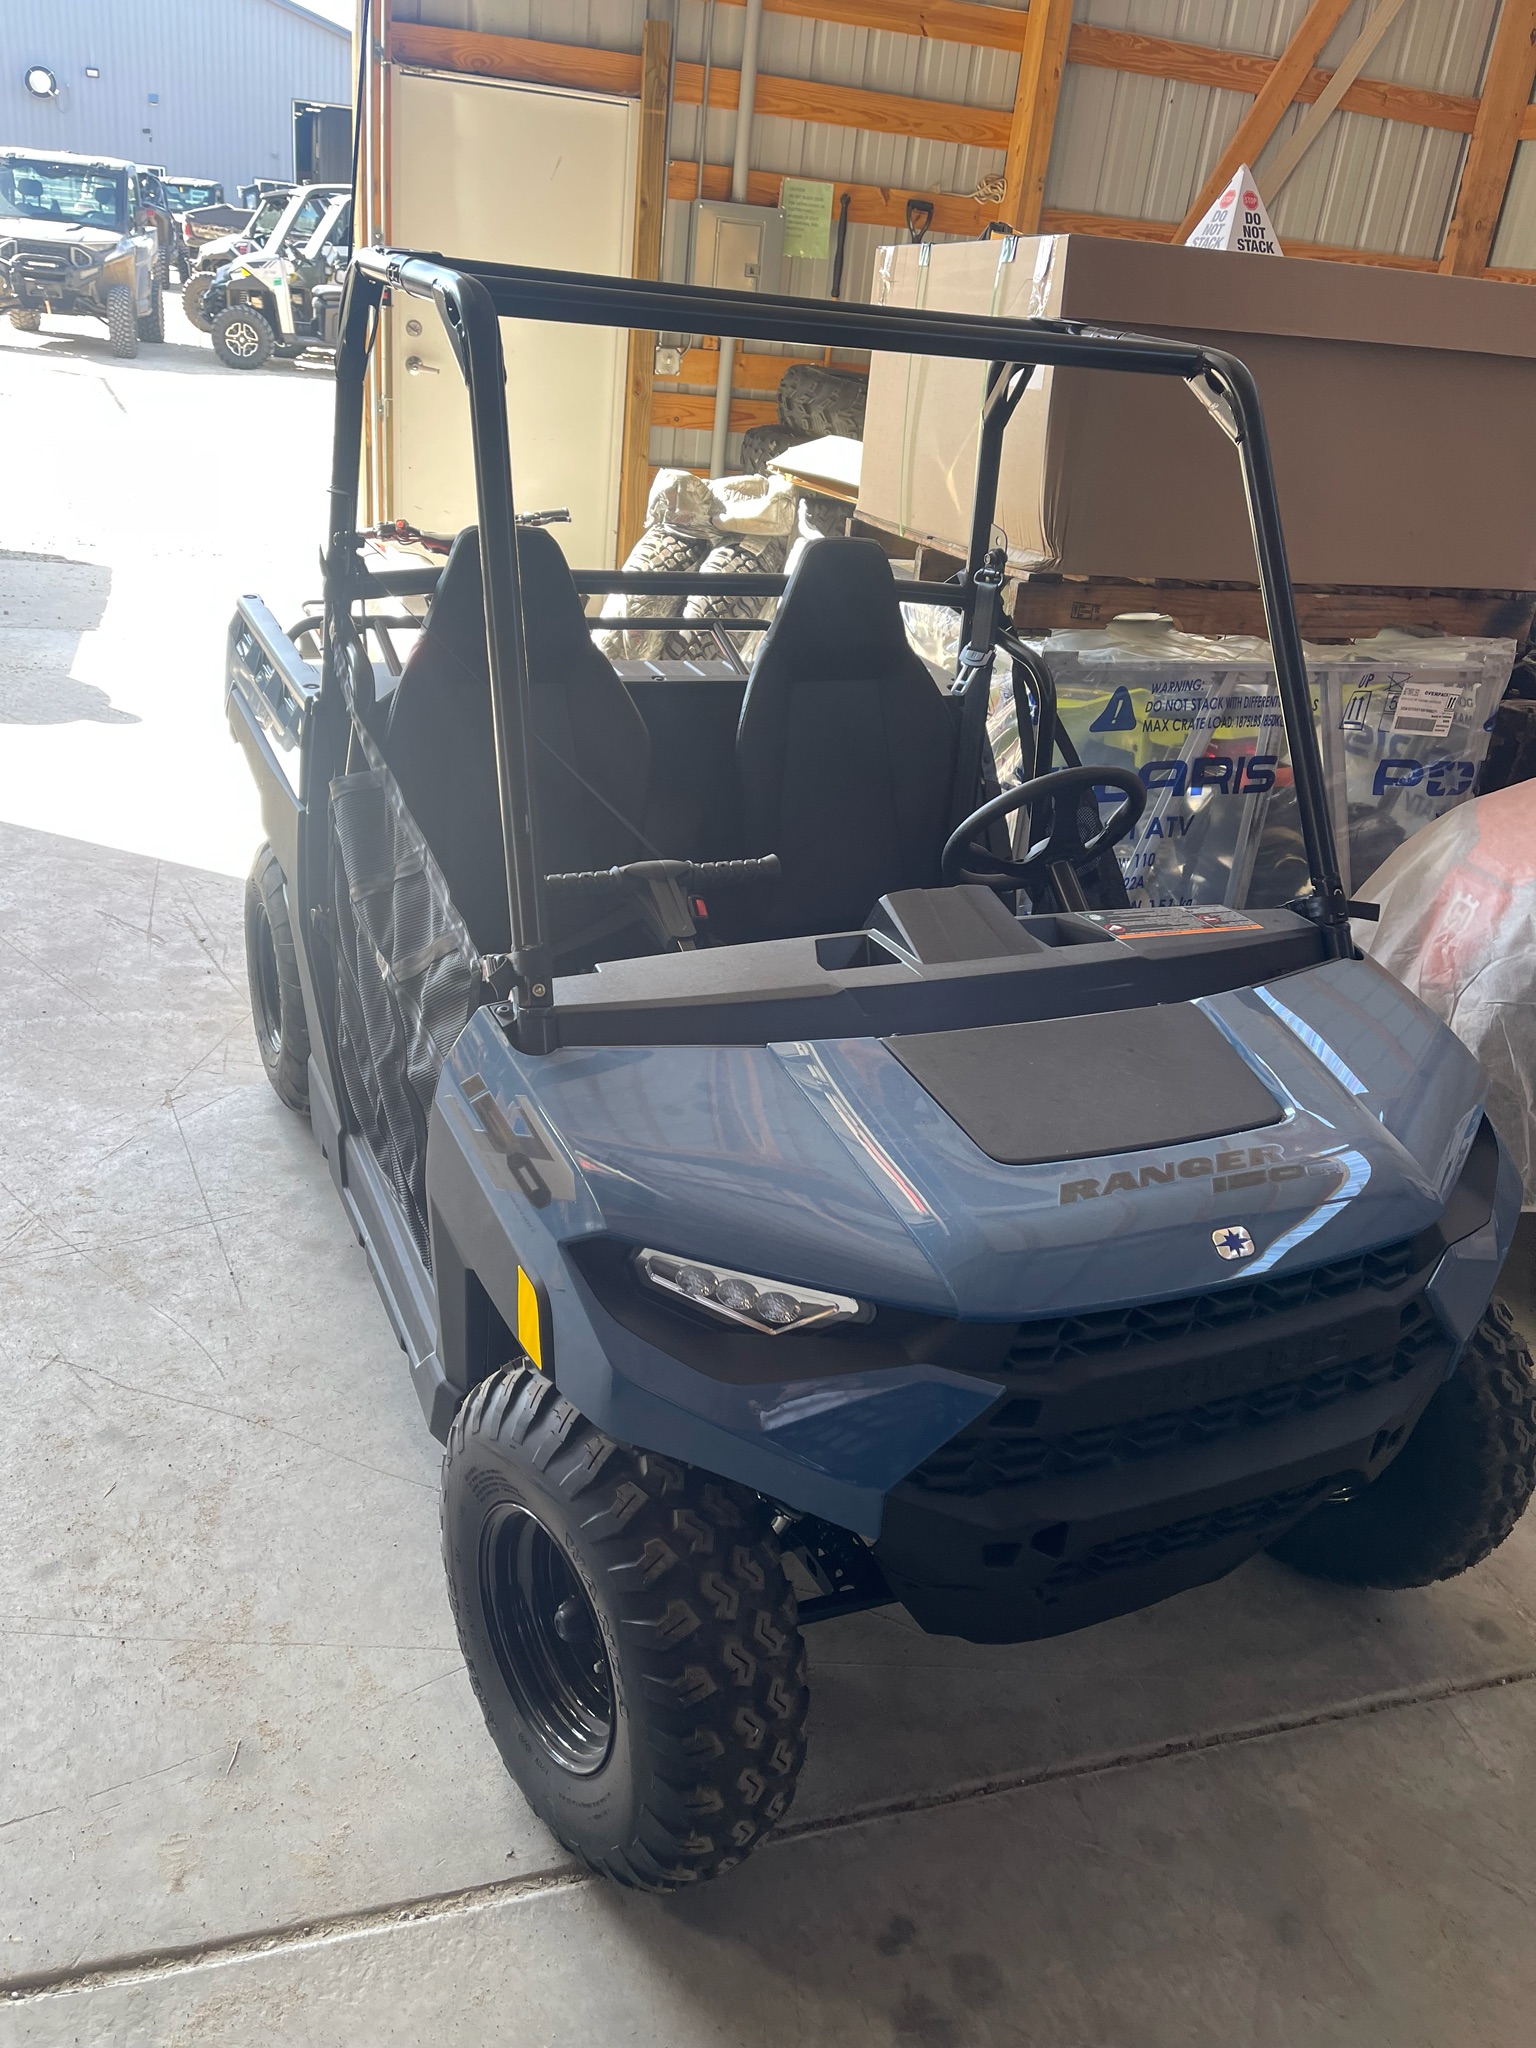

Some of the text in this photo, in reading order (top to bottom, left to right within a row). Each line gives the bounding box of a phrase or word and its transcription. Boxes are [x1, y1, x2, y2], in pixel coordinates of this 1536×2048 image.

[1212, 210, 1228, 222] DO
[1245, 212, 1261, 225] DO
[1202, 223, 1225, 235] NOT
[1243, 225, 1266, 239] NOT
[1237, 238, 1274, 254] STACK
[1151, 678, 1205, 695] WARNING:
[1358, 673, 1375, 688] UP
[1145, 701, 1162, 713] DO
[1165, 699, 1188, 712] NOT
[1191, 697, 1224, 711] STACK
[1226, 696, 1242, 709] WITH
[1243, 695, 1279, 709] DIFFERENT
[1142, 719, 1169, 733] MAX
[1172, 716, 1206, 731] CRATE
[1208, 716, 1234, 729] LOAD:
[1145, 815, 1196, 839] ATV
[1135, 853, 1156, 868] 110
[1059, 1144, 1285, 1206] RANGER
